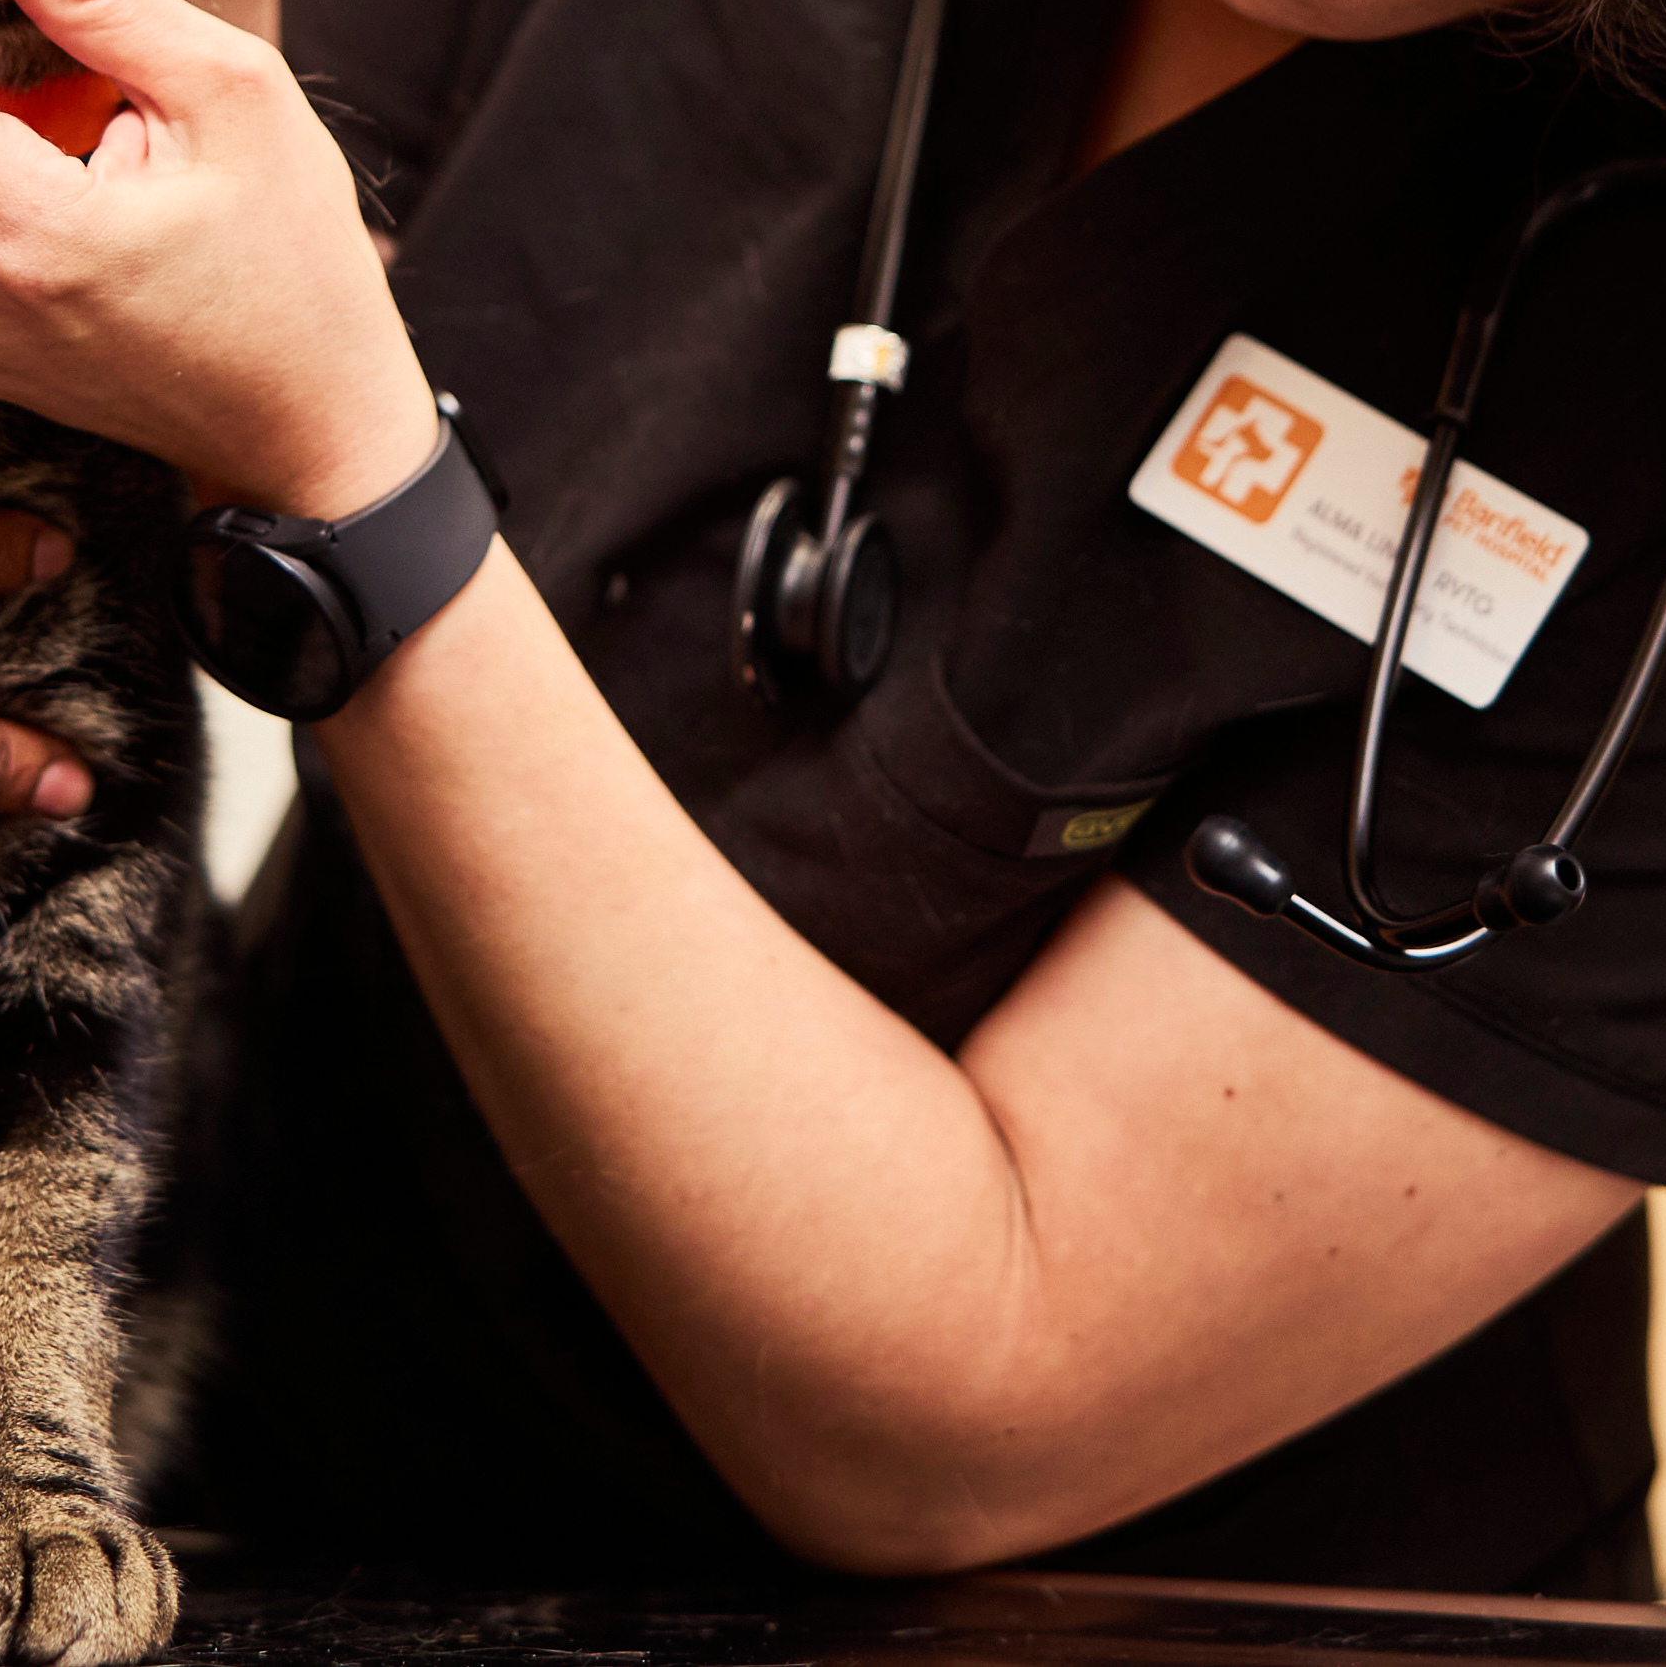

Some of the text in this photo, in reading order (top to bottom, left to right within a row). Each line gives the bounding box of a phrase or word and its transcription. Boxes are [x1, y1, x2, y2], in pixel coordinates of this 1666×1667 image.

[1307, 496, 1365, 540] ALMA
[1443, 512, 1550, 584] PET HOSPITAL
[1453, 485, 1569, 569] Banfield
